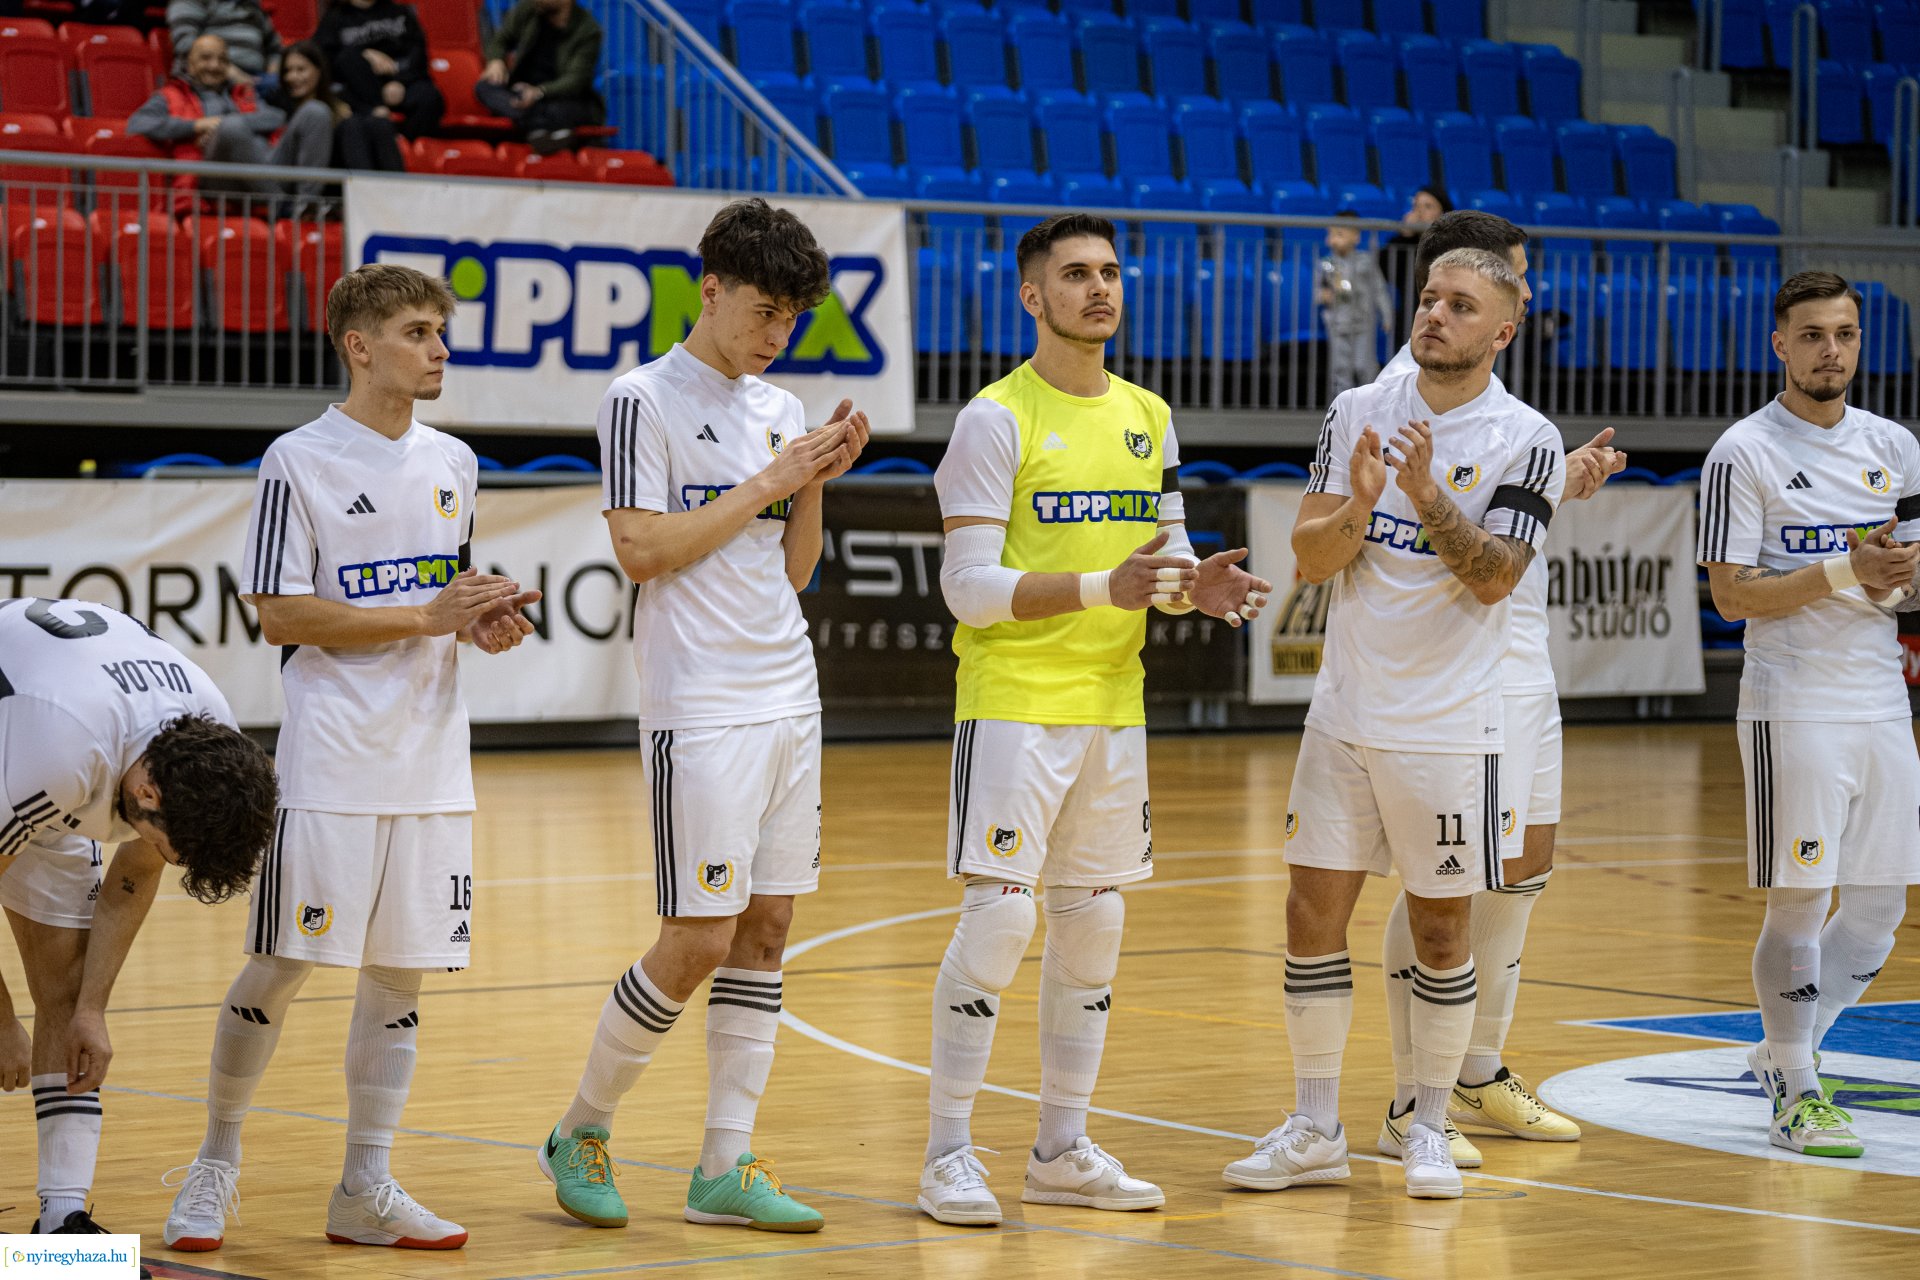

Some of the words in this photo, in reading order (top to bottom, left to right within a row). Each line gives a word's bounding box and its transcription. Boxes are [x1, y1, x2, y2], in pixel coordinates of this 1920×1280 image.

[1152, 621, 1215, 646] KFT
[101, 659, 192, 694] ULLOA
[1436, 814, 1466, 846] 11
[1436, 867, 1465, 876] adidas
[450, 875, 471, 910] 16
[1779, 991, 1820, 1003] adida
